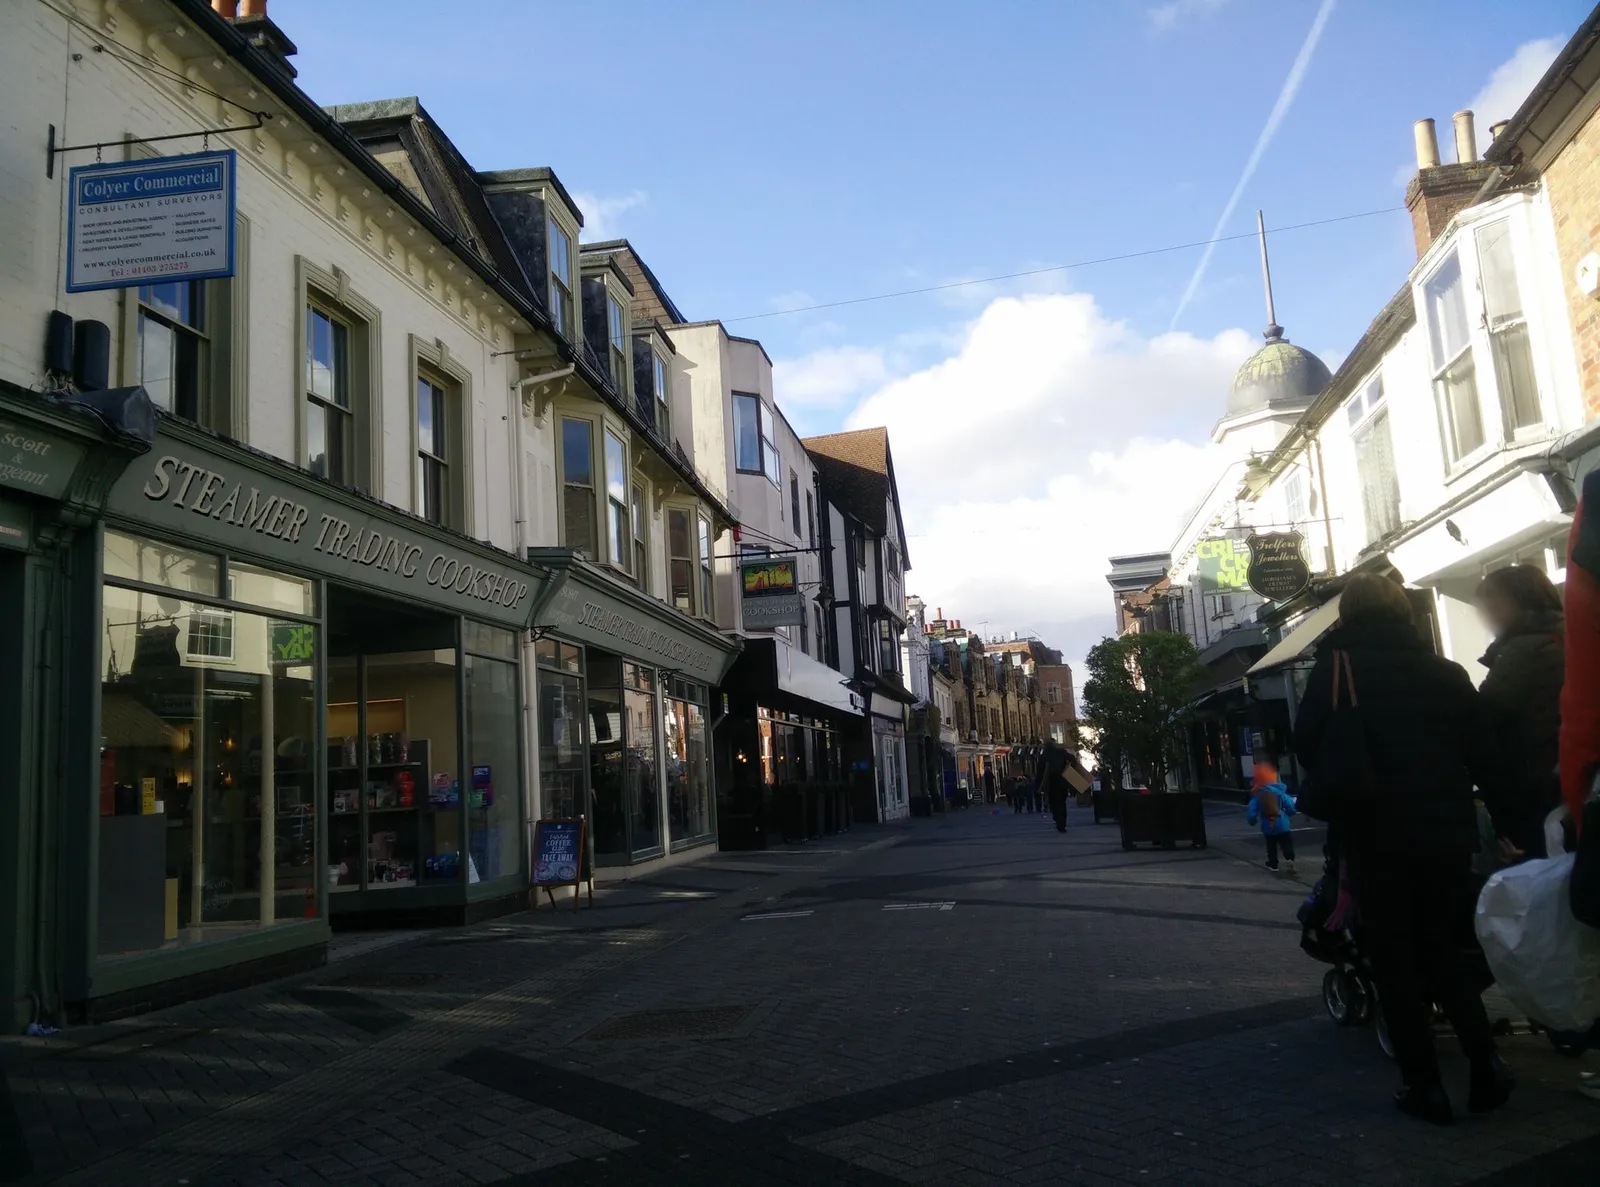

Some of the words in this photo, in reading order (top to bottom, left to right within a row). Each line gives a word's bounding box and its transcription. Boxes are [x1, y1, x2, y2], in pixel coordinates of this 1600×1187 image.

[83, 179, 130, 199] Colyer
[134, 168, 219, 192] Commercial
[79, 201, 151, 215] CONSULTANT
[157, 193, 222, 207] SURVEYORS
[108, 242, 142, 250] MANAGEMENT
[83, 248, 216, 269] www.colyercommercial.co.uk
[0, 432, 52, 456] scott
[11, 452, 24, 465] &
[144, 455, 309, 544] STEAMER
[314, 513, 424, 579] TRADING
[426, 554, 528, 610] COOKSHOP
[1196, 538, 1234, 559] CRI
[1255, 552, 1298, 566] Jewellers
[743, 605, 799, 616] COOKSHOP
[577, 601, 624, 638] STEAMER
[621, 621, 657, 650] TRADING
